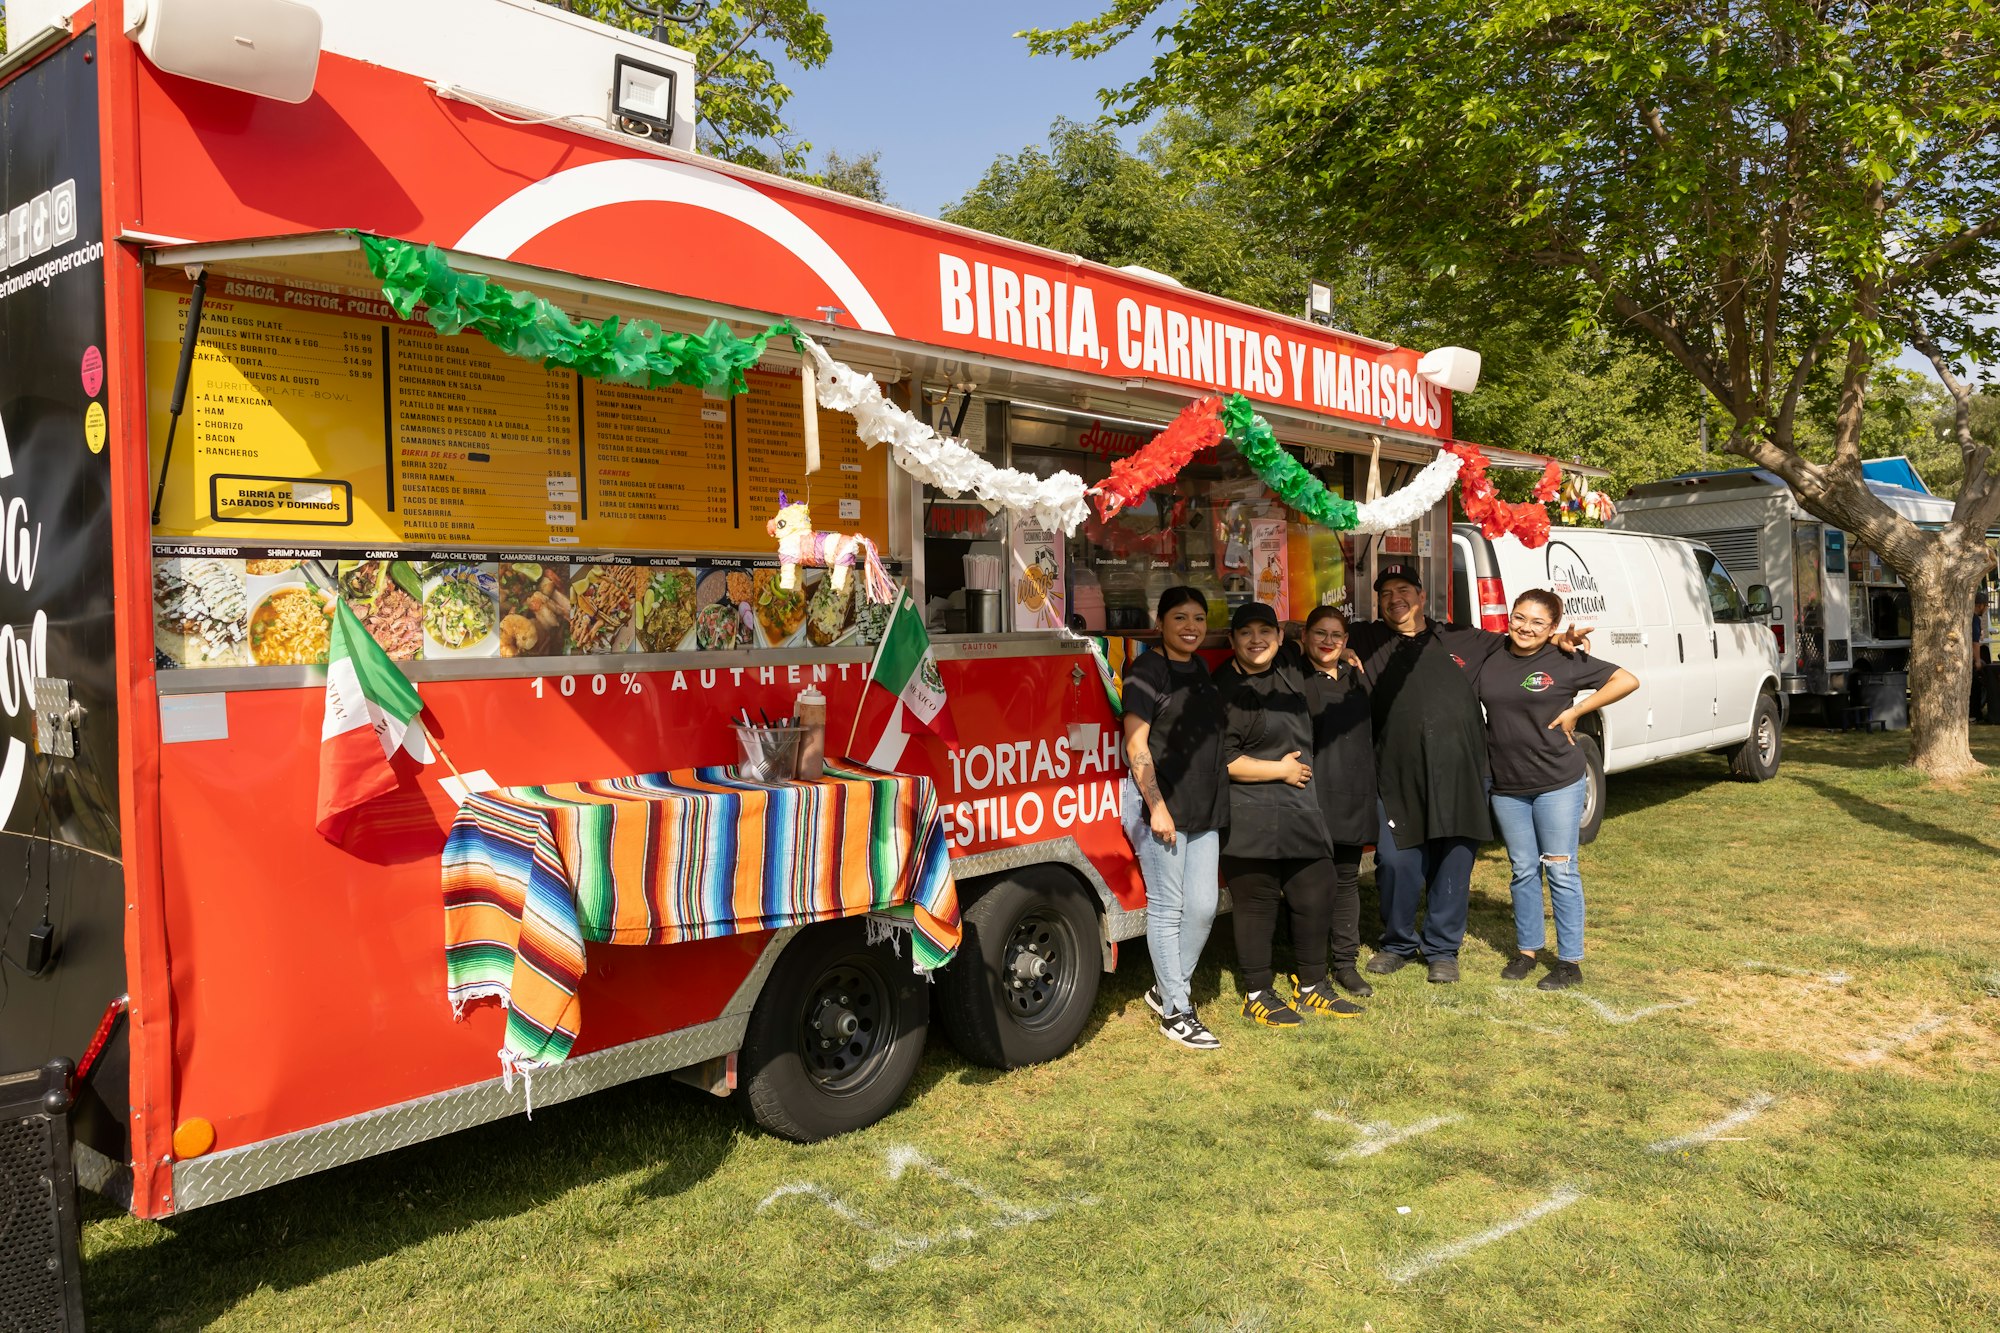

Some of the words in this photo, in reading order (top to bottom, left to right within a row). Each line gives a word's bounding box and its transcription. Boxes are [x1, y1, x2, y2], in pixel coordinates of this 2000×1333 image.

[178, 297, 234, 311] BRKFAST
[225, 282, 279, 303] ASADA,
[284, 290, 343, 312] PASTOR,
[347, 301, 393, 319] POLLO,
[178, 310, 207, 320] STK
[211, 313, 229, 323] AND
[232, 316, 254, 326] EGGS
[256, 320, 283, 330] PLATE
[343, 332, 372, 342] $15.99
[240, 331, 262, 340] WITH
[264, 334, 292, 344] STEAK
[303, 339, 318, 348] EGG
[344, 344, 372, 354] $15.99
[398, 339, 432, 350] PLATILLO
[446, 346, 470, 355] ASADA
[938, 253, 1109, 370] BIRRIA,
[1116, 297, 1284, 398] CARNITAS
[1288, 341, 1307, 402] Y
[1312, 346, 1443, 430] MARISCOS
[240, 345, 278, 356] BURRITO
[344, 357, 372, 367] $14.99
[236, 357, 263, 367] TORTA
[349, 370, 372, 379] $9.99
[398, 352, 432, 362] PLATILLO
[469, 360, 491, 369] VERDE
[547, 370, 569, 379] $15.99
[399, 364, 433, 374] PLATILLO
[446, 370, 467, 378] CHILE
[469, 372, 505, 382] COLORADO
[244, 370, 277, 381] HUEVOS
[280, 375, 290, 383] AL
[293, 376, 320, 386] GUSTO
[399, 376, 446, 387] CHICHARRON
[460, 382, 482, 391] SALSA
[227, 396, 273, 407] MEXICANA
[400, 388, 425, 397] BISTEC
[428, 391, 466, 401] RANCHERO
[546, 403, 569, 412] $15.99
[205, 407, 224, 415] HAM
[939, 406, 954, 432] A
[205, 421, 243, 430] CHORIZO
[206, 434, 235, 442] BACON
[400, 437, 446, 447] CAMARONES
[448, 440, 490, 450] RANCHEROS
[206, 447, 259, 458] RANCHEROS
[401, 449, 428, 458] BIRRIA
[1304, 447, 1335, 466] DRINKS
[429, 474, 455, 482] RAMEN
[598, 469, 630, 477] CARNITAS
[239, 490, 275, 499] BIRRIA
[402, 484, 450, 494] QUESATACOS
[221, 499, 274, 508] SABADOS
[287, 501, 340, 510] DOMINGOS
[440, 498, 464, 506] BIRRIA
[403, 509, 451, 517] QUESABIRRIA
[155, 547, 206, 556] CHILAQUILES
[207, 548, 238, 556] BURRITO
[267, 549, 295, 558] SHRIMP
[295, 550, 322, 558] RAMEN
[1322, 585, 1347, 605] AGUAS
[1562, 595, 1606, 616] neracion
[530, 672, 643, 698] 100%
[671, 663, 869, 691] AUTHENTI
[908, 683, 937, 712] MEXICO
[948, 736, 1071, 793] TORTAS
[1078, 731, 1129, 775] AH
[939, 792, 1044, 849] ESTILO
[1053, 778, 1126, 828] GUA
